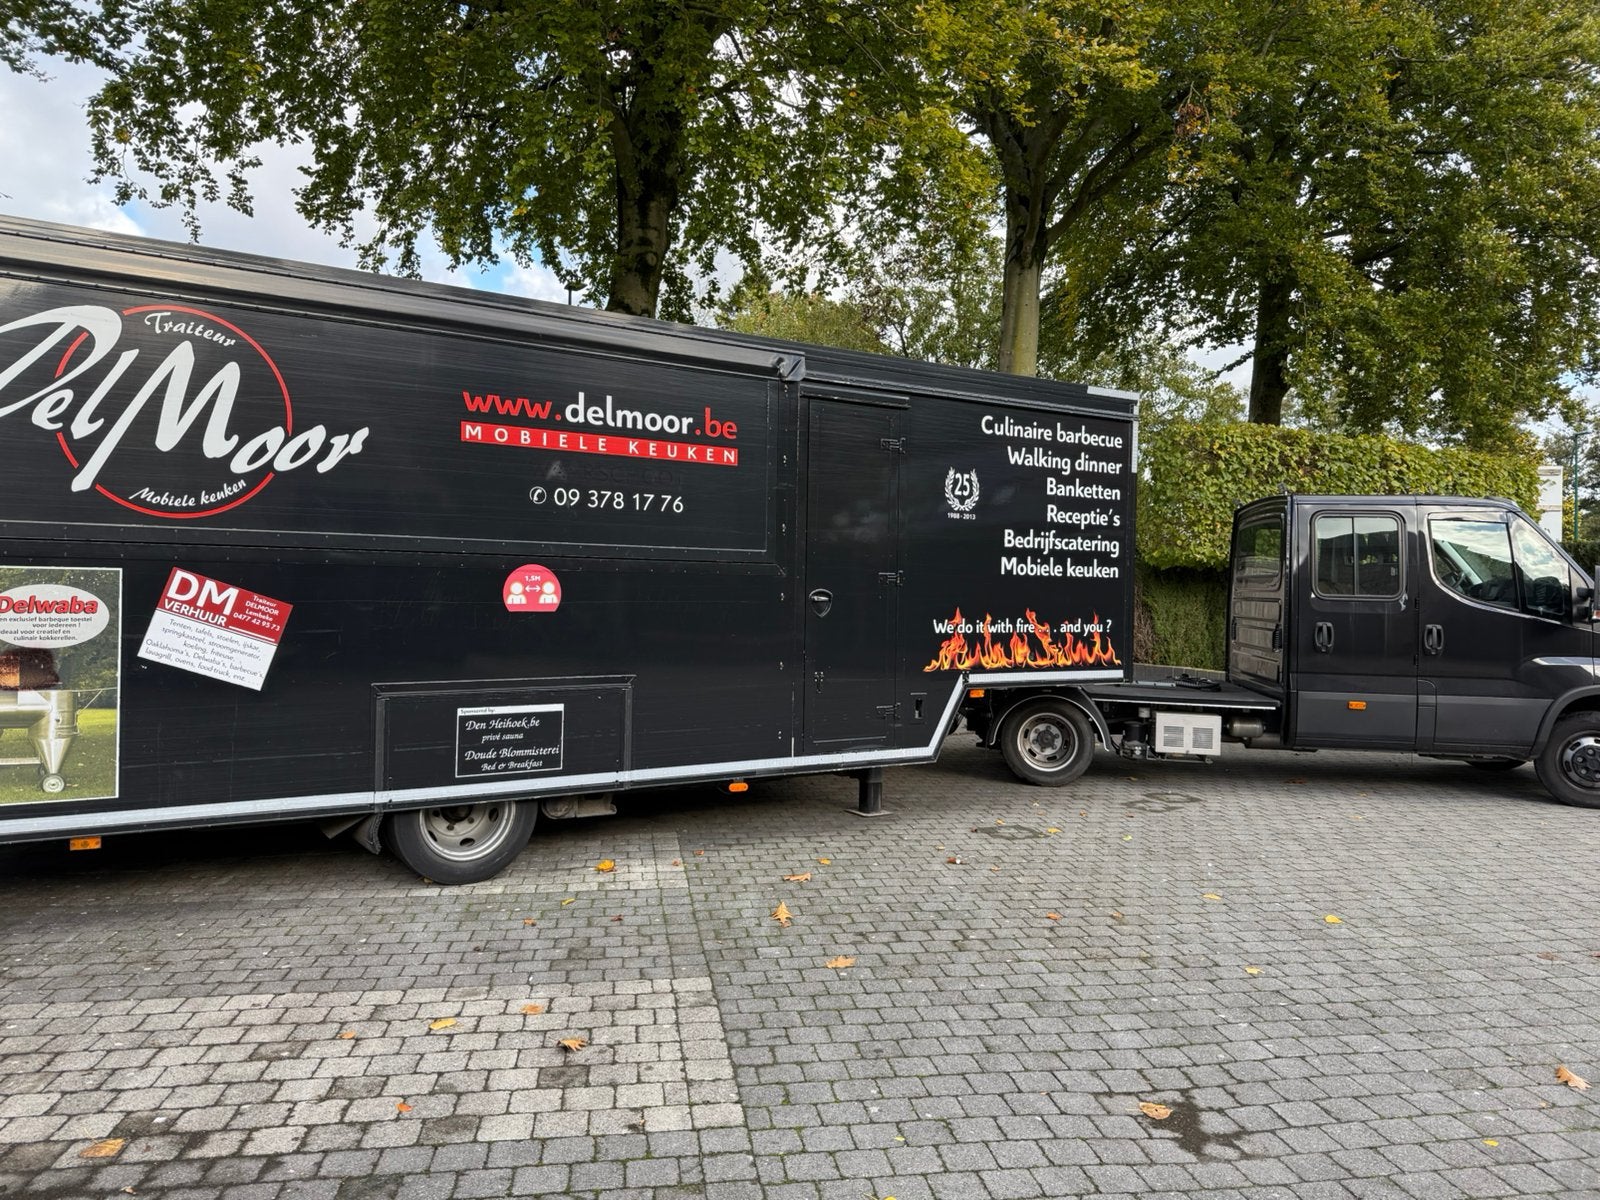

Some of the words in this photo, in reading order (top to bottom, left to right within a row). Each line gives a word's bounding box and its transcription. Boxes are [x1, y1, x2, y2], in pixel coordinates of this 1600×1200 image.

[144, 312, 236, 347] Traiteur
[462, 391, 738, 439] www.delmoor.be
[465, 424, 607, 452] MOBIELE
[629, 440, 736, 463] KEUKEN
[981, 415, 1052, 441] Culinaire
[1057, 422, 1123, 448] barbecue
[1007, 445, 1071, 475] Walking
[1075, 452, 1122, 475] dinner
[129, 487, 196, 507] Mobiele
[200, 478, 247, 505] keuken
[954, 472, 970, 496] 25
[1046, 477, 1121, 500] Banketten
[554, 487, 580, 506] 09
[588, 490, 625, 510] 378
[633, 493, 654, 511] 17
[661, 495, 684, 513] 76
[1046, 504, 1121, 530] Receptie's
[1004, 529, 1120, 558] Bedrijfscatering
[1001, 556, 1063, 577] Mobiele
[1066, 557, 1119, 578] keuken
[0, 594, 99, 614] Delwaba
[166, 569, 239, 616] DM
[162, 598, 227, 626] VERHUUR
[245, 600, 279, 615] DELMOOR
[245, 608, 273, 621] Lembeke
[232, 612, 250, 621] 0477
[251, 617, 261, 625] 42
[270, 624, 280, 632] 73
[933, 619, 954, 634] We
[957, 618, 973, 634] do
[976, 619, 984, 633] it
[987, 619, 1013, 634] with
[1015, 618, 1035, 633] fire
[1060, 618, 1081, 633] and
[1083, 622, 1103, 637] you
[465, 720, 487, 731] Den
[481, 732, 500, 744] privé
[502, 733, 524, 741] sauna
[464, 748, 497, 761] Doude
[499, 745, 560, 758] Blommisterei
[481, 762, 496, 771] Bed
[498, 762, 506, 770] &
[507, 759, 543, 769] Breakfast
